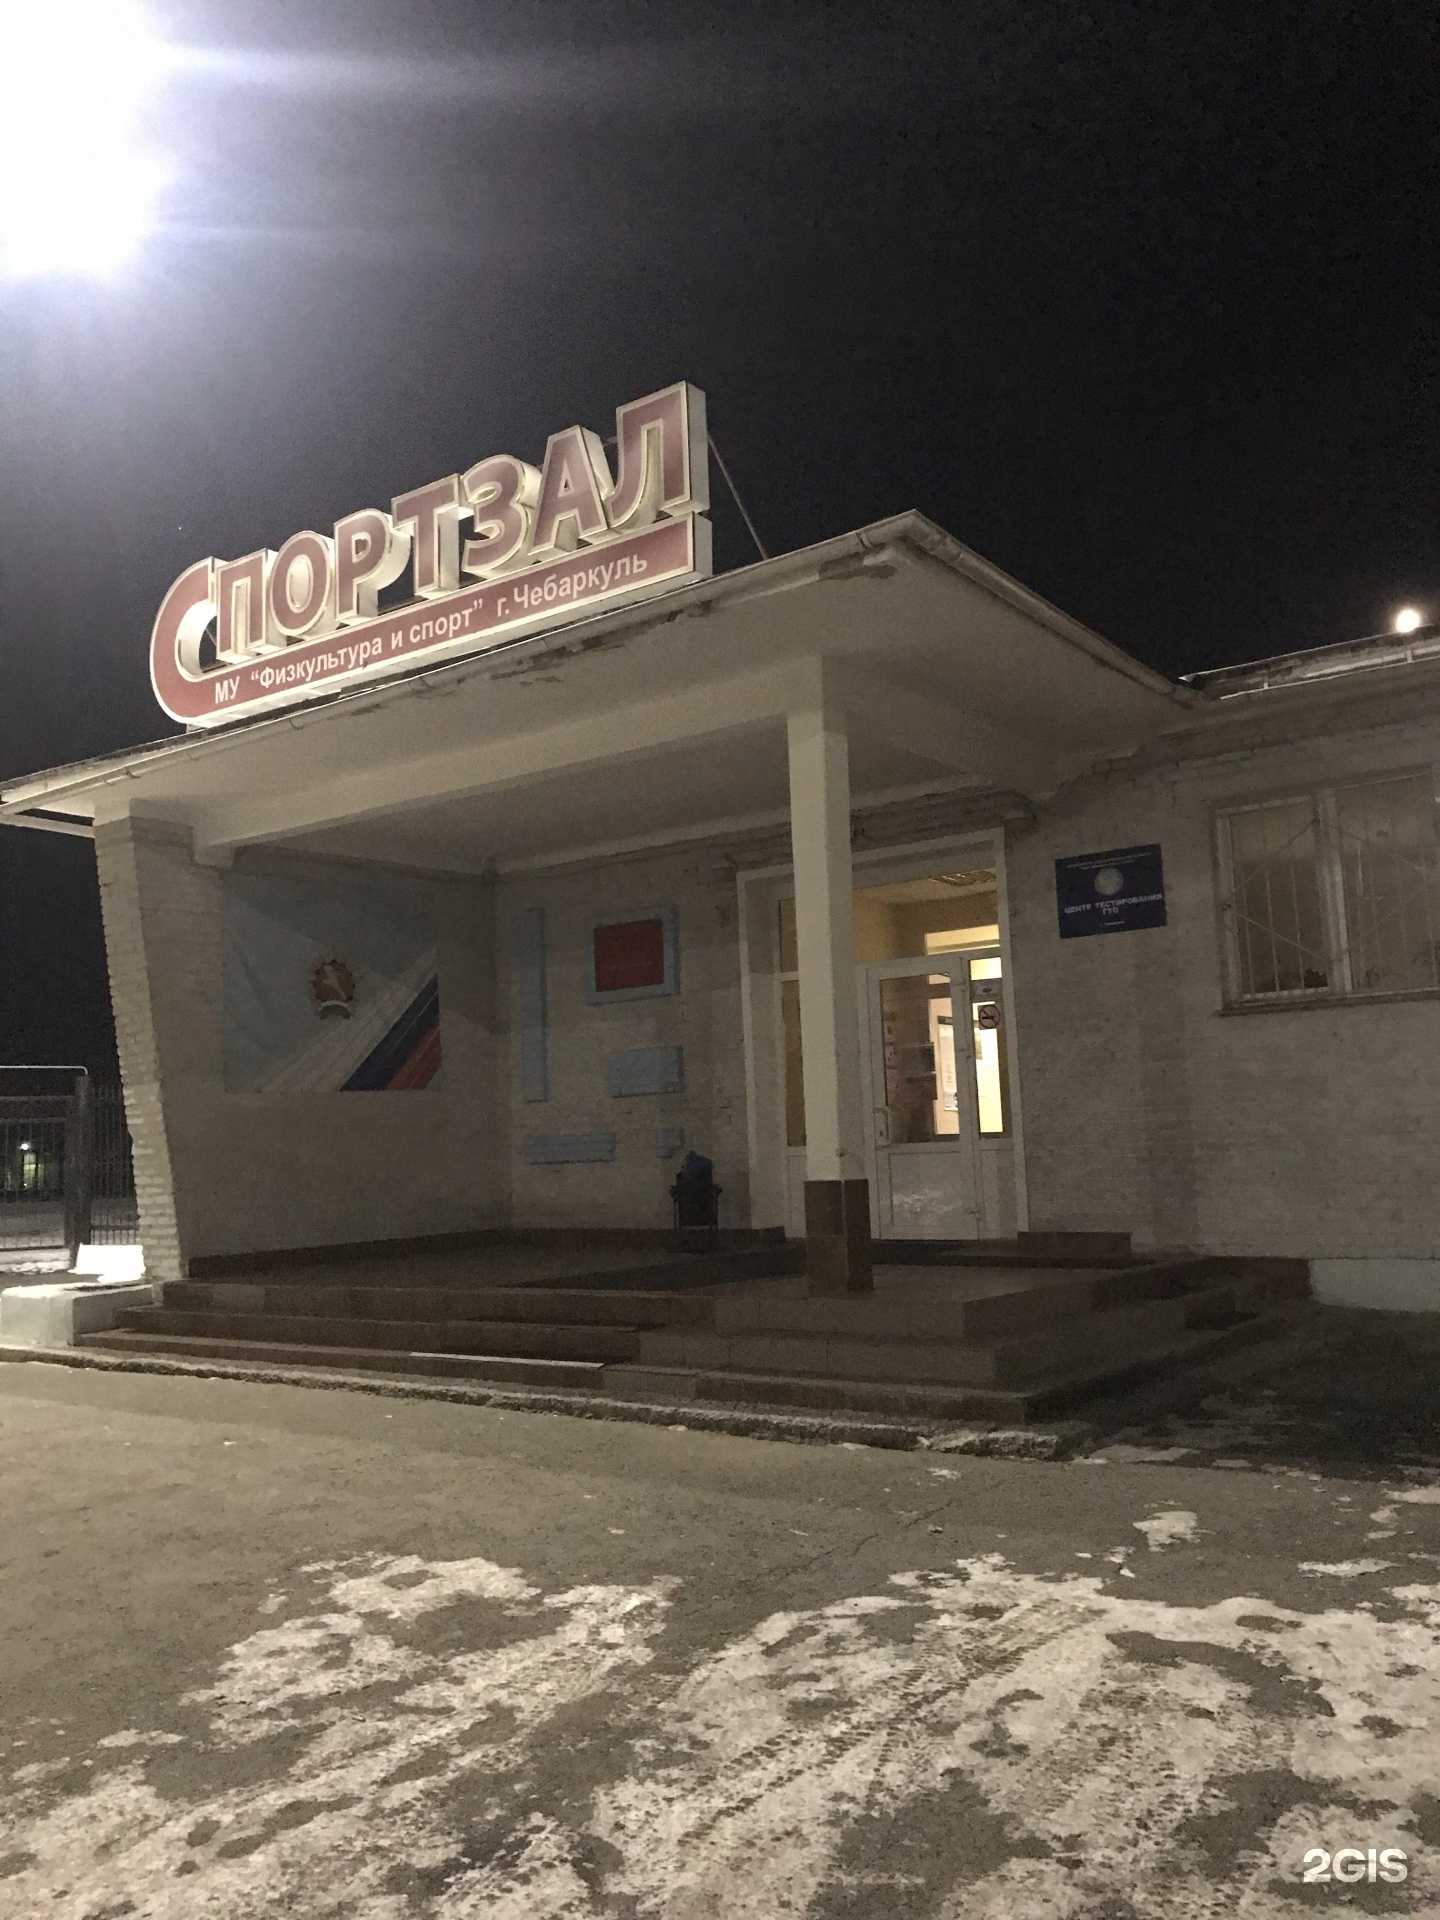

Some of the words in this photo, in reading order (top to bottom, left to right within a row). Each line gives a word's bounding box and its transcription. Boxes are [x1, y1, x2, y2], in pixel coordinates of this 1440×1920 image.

[149, 380, 708, 726] СПОРТЗАЛ
[214, 675, 241, 705] МУ
[391, 629, 404, 650] и
[513, 552, 648, 609] Чебаркуль
